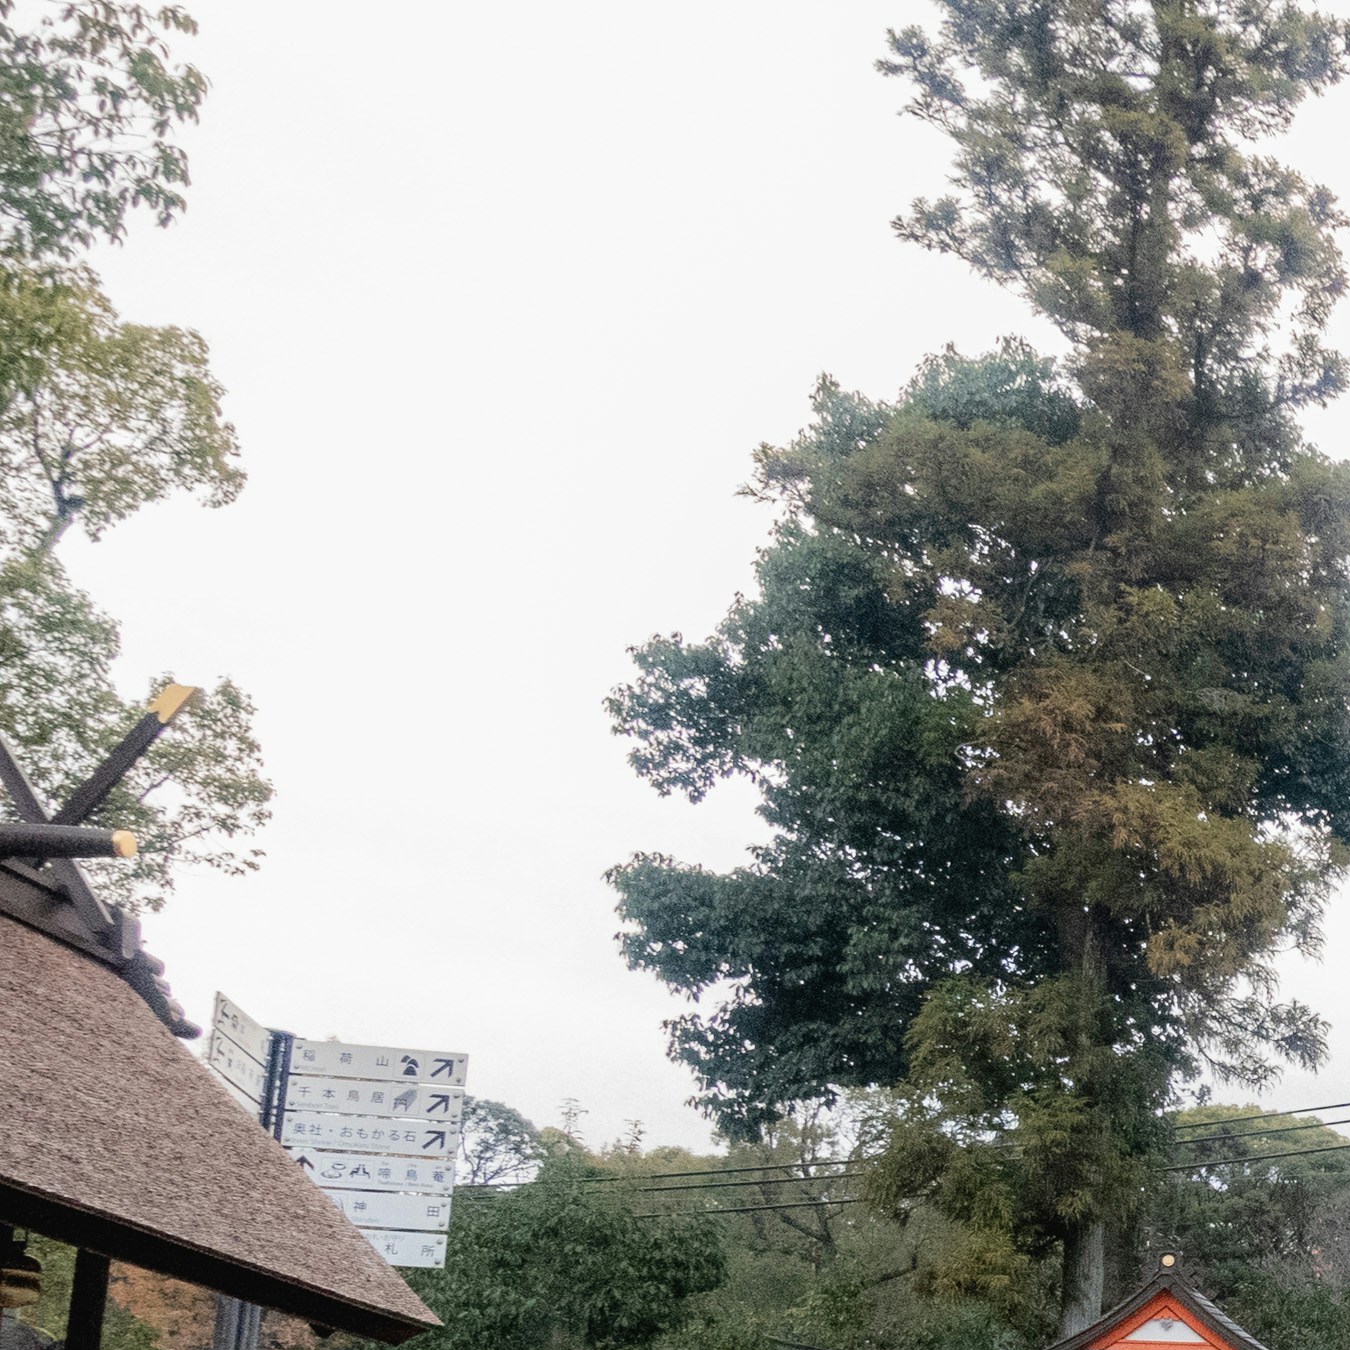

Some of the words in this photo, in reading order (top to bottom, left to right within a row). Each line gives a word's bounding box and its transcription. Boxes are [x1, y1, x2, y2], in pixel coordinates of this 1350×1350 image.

[302, 1049, 389, 1067] 稲荷山
[298, 1086, 385, 1103] 千本鳥居
[293, 1122, 418, 1142] 奥社・おもかる石
[353, 1201, 440, 1218] 神田
